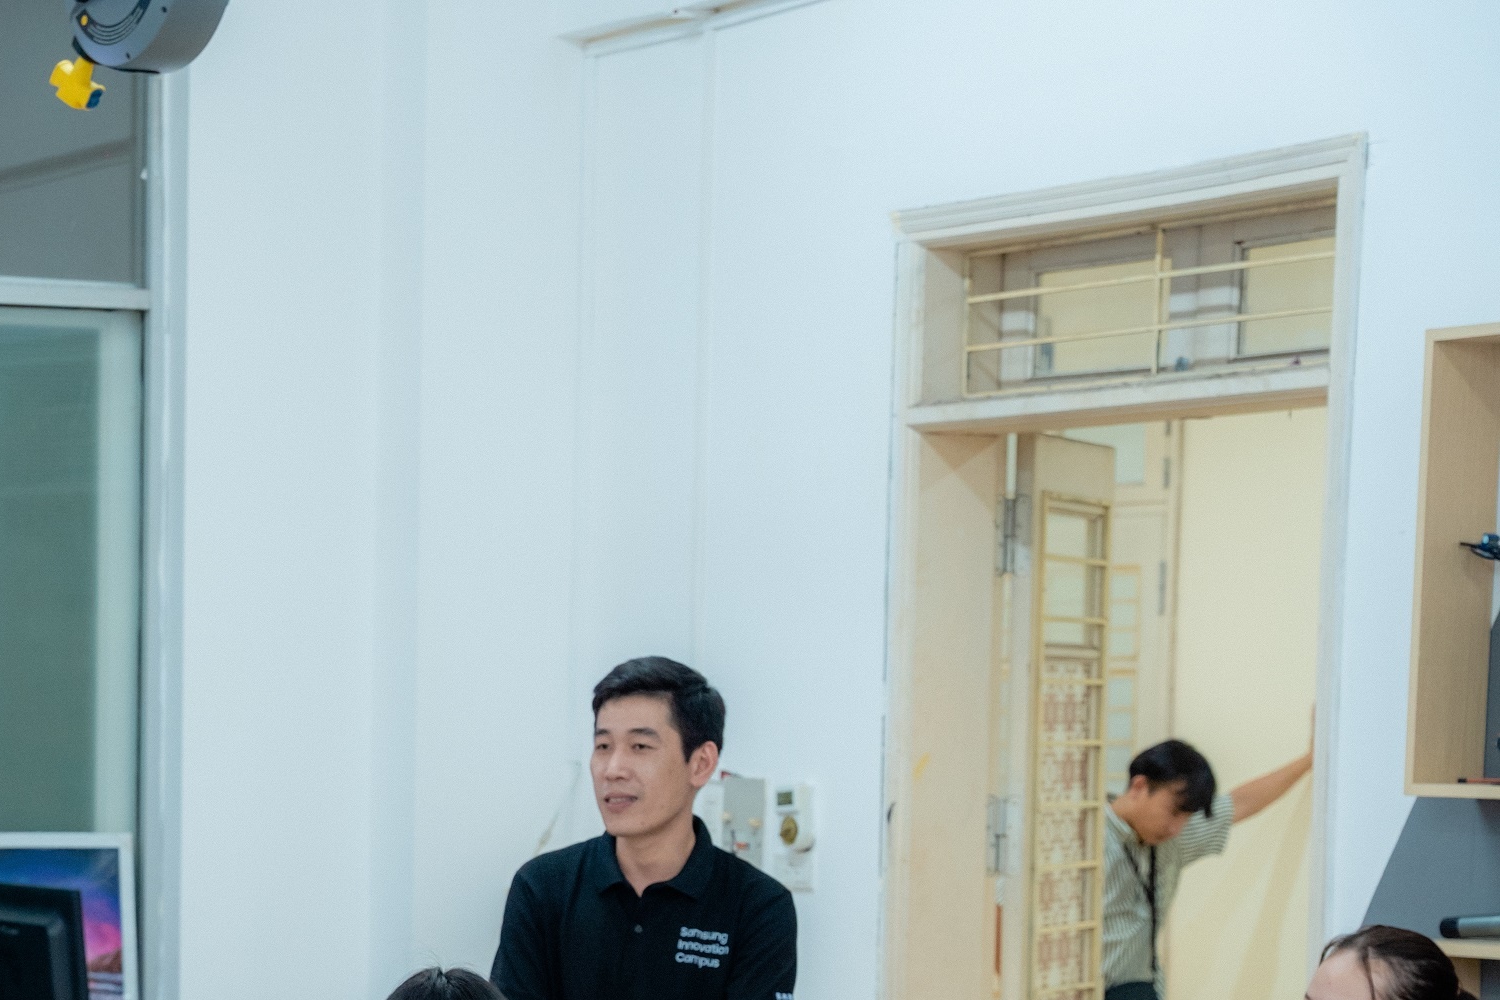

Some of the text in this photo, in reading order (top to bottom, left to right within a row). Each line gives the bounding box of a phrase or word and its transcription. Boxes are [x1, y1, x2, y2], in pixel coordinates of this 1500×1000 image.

[680, 926, 729, 945] Samsung
[677, 939, 729, 955] Innovation
[675, 952, 720, 968] Campus
